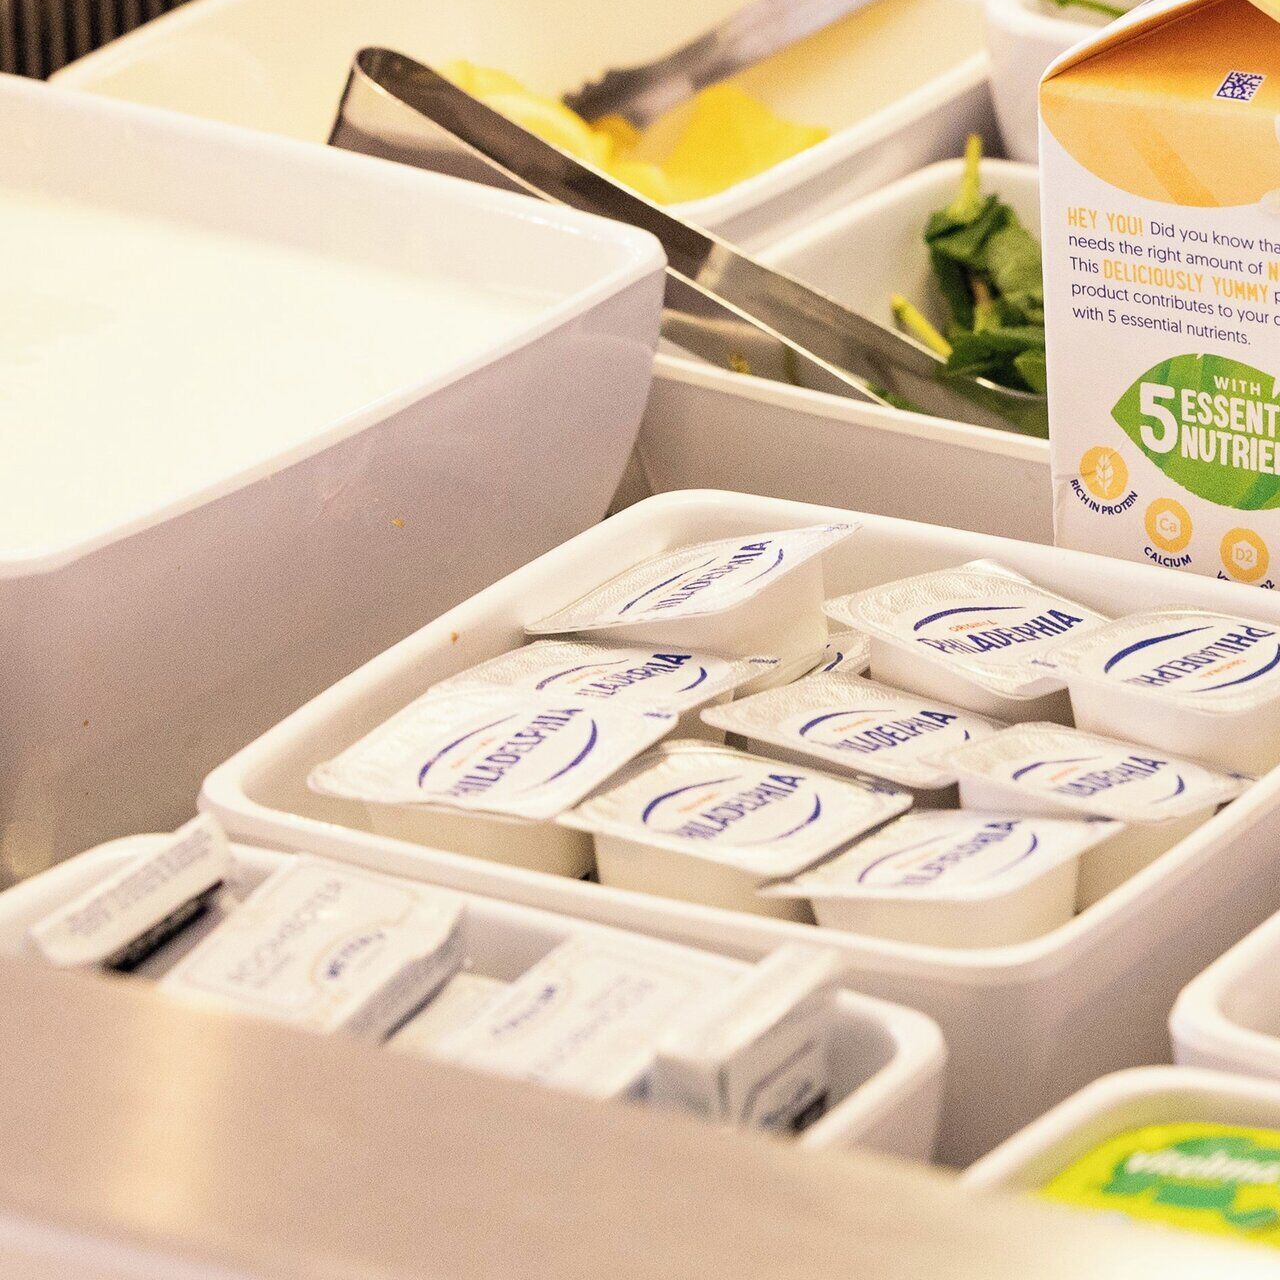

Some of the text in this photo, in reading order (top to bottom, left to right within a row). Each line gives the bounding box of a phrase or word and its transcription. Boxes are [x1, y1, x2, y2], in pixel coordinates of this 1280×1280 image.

[1067, 207, 1097, 229] HEY
[1106, 212, 1144, 237] YOU!
[1151, 221, 1175, 238] Did
[1179, 228, 1208, 243] you
[1213, 230, 1254, 250] know
[1069, 234, 1115, 252] needs
[1119, 240, 1143, 256] the
[1148, 245, 1182, 263] right
[1186, 253, 1244, 272] amount
[1247, 261, 1263, 276] of
[1069, 256, 1099, 274] This
[1103, 259, 1204, 293] DELICIOUSLY
[1212, 276, 1268, 304] YUMMY
[1072, 283, 1129, 302] product
[1133, 292, 1214, 315] contributes
[1218, 304, 1233, 318] to
[1237, 309, 1269, 324] your
[1072, 306, 1251, 345] with 5 essential nutrients.
[1213, 375, 1262, 396] WITH
[1139, 382, 1179, 455] 5
[1069, 478, 1139, 515] RICH IN PROTEIN
[1158, 518, 1177, 533] Ca
[1143, 546, 1192, 568] CALCIUM
[1235, 547, 1253, 563] D2
[916, 609, 1084, 655] PHILADELPHIA
[575, 652, 692, 699] ILADELPHIA
[1122, 624, 1276, 687] PHILADELPH
[812, 710, 959, 754] HILADELPHIA
